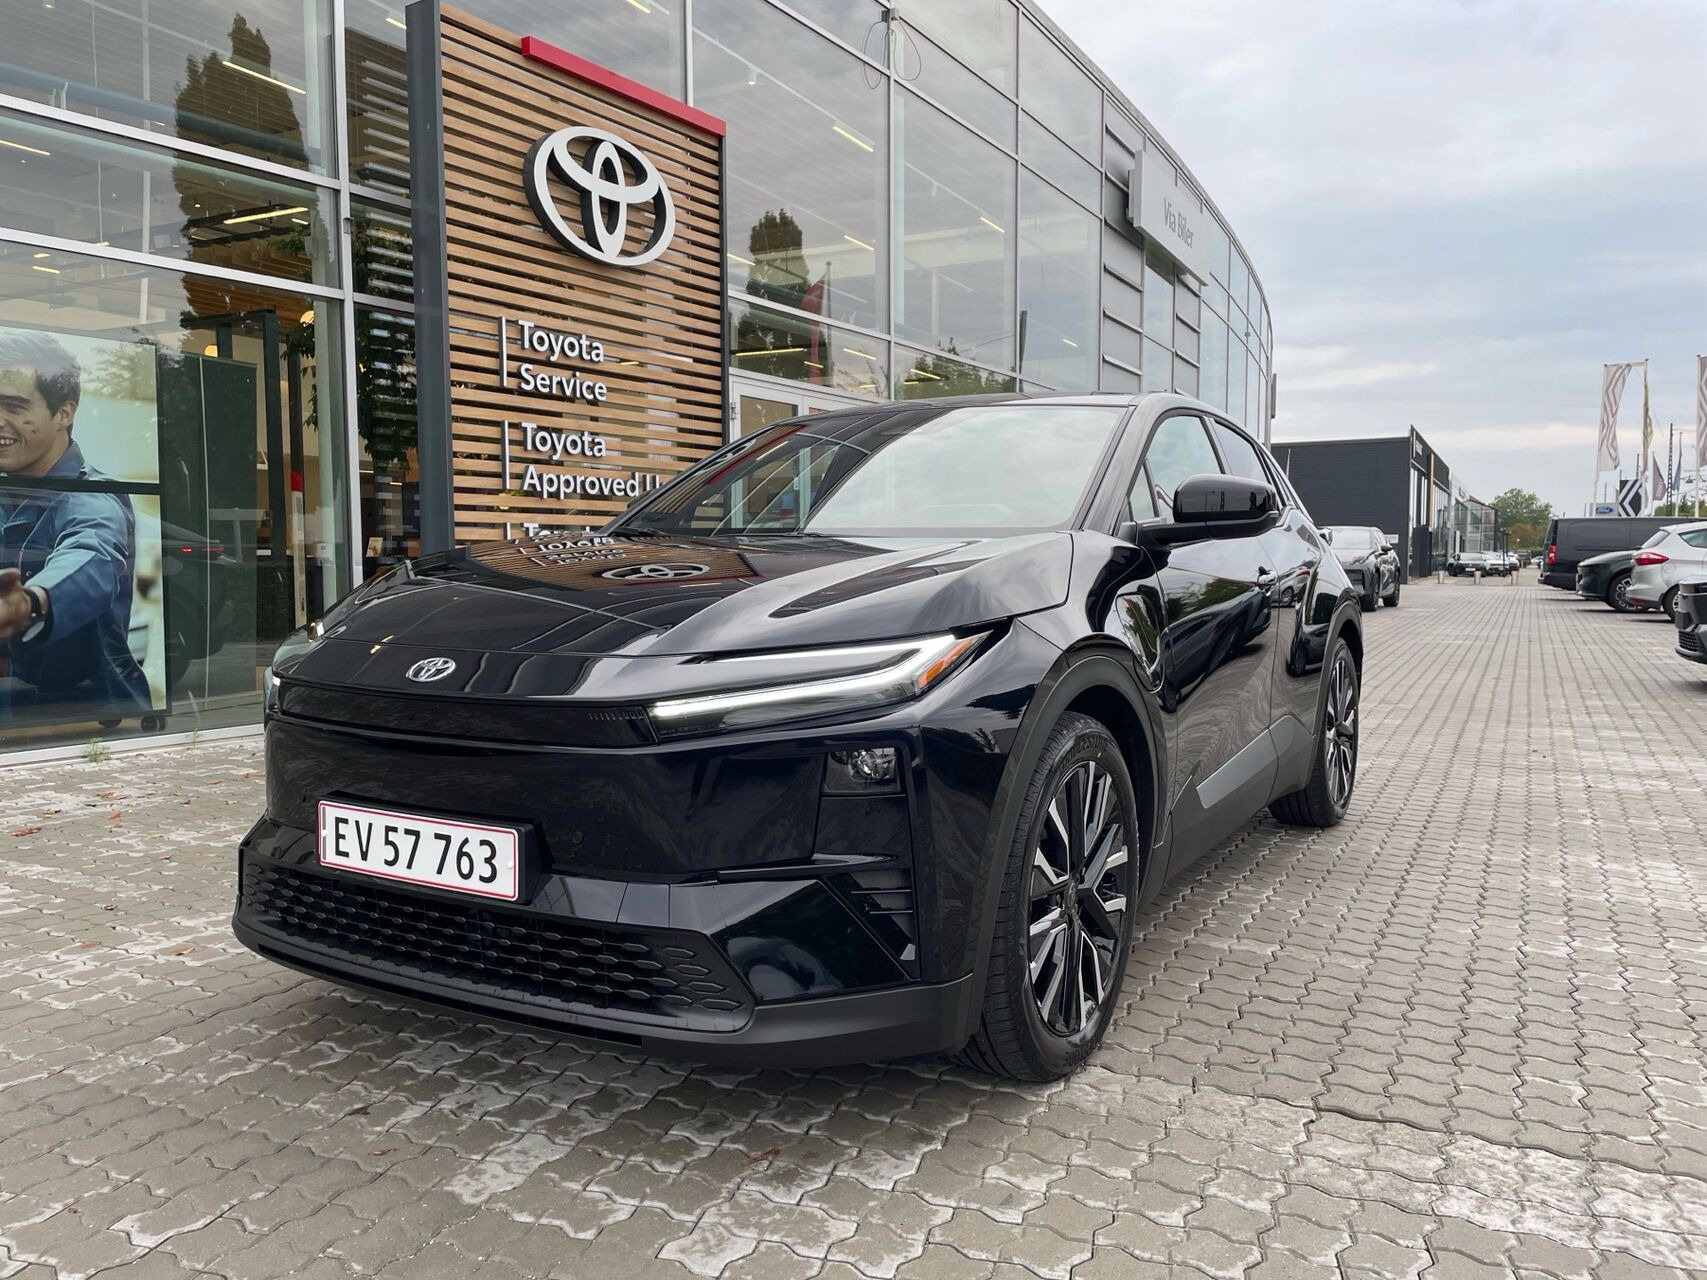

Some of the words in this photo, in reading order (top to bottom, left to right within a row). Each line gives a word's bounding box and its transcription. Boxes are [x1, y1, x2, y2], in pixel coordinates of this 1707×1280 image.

[1163, 197, 1176, 233] Via
[518, 319, 604, 362] Toyota
[520, 363, 608, 401] Service
[521, 421, 606, 461] Toyota
[523, 464, 639, 500] Approved
[334, 816, 373, 862] EV
[384, 825, 421, 870] 57
[433, 832, 498, 884] 763
